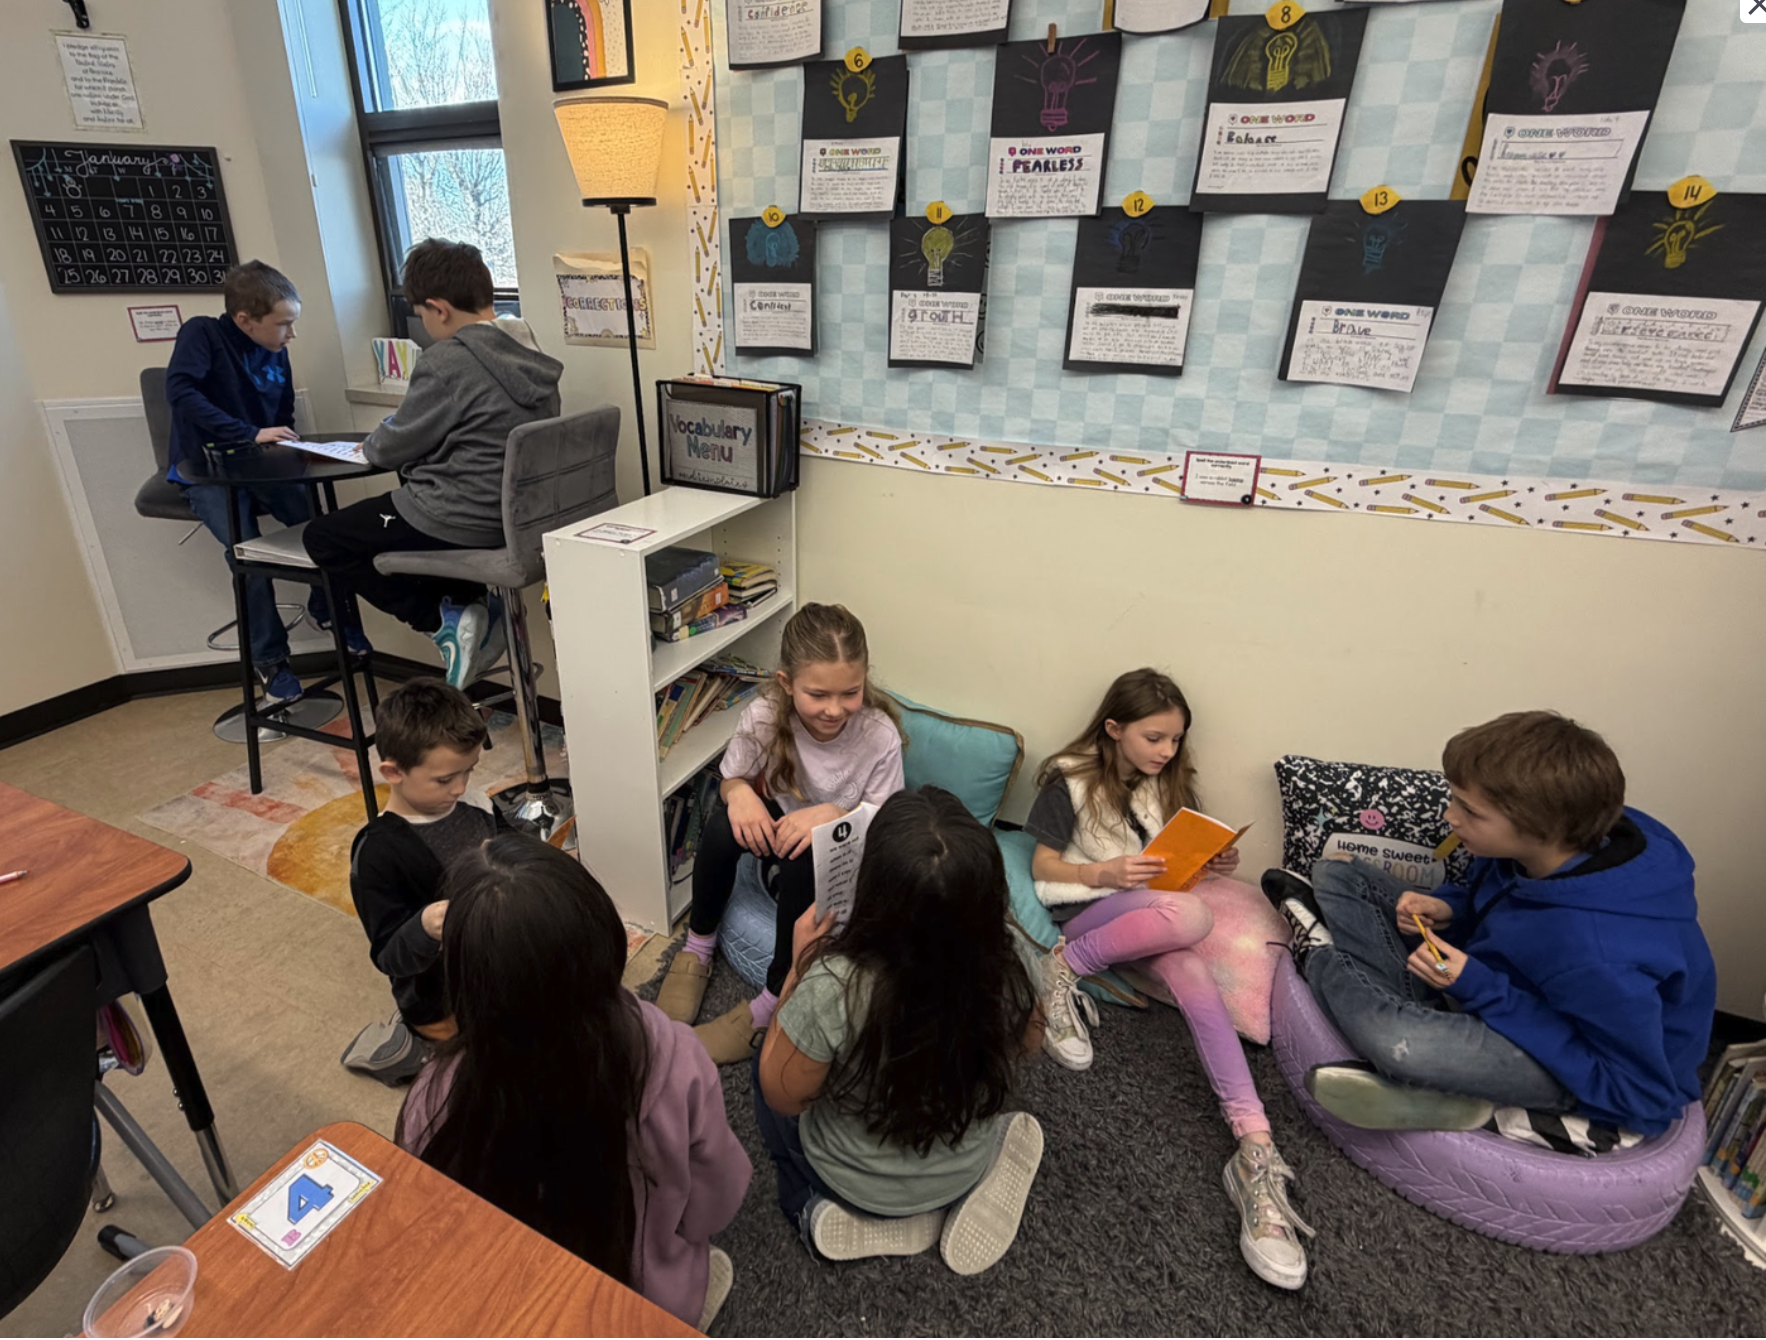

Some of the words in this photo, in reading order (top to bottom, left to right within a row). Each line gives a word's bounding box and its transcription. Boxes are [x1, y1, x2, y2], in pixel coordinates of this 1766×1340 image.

[1280, 6, 1291, 23] 8
[854, 53, 864, 68] 6
[1240, 115, 1270, 124] ONE
[1272, 114, 1315, 123] WORD
[1518, 128, 1554, 138] ONE
[1556, 127, 1612, 138] WORD
[829, 148, 850, 156] ONE
[852, 148, 881, 156] WORD
[1046, 146, 1082, 155] WORD
[64, 150, 160, 177] January
[1012, 158, 1084, 173] FEARLESS
[148, 186, 155, 197] 1
[172, 185, 182, 198] 2
[197, 186, 207, 199] 3
[1375, 191, 1388, 207] 13
[1684, 185, 1702, 201] 14
[1134, 198, 1144, 212] 12
[44, 204, 57, 217] 4
[70, 205, 83, 218] 5
[100, 206, 111, 218] 6
[123, 204, 135, 218] 7
[151, 204, 162, 219] 8
[176, 206, 188, 219] 9
[201, 208, 214, 221] 10
[768, 212, 780, 222] 10
[936, 206, 942, 219] 11
[50, 227, 64, 239] 11
[76, 227, 89, 241] 12
[102, 228, 116, 241] 13
[129, 227, 144, 240] 14
[154, 227, 169, 241] 15
[180, 227, 195, 241] 16
[204, 227, 217, 241] 17
[53, 247, 72, 263] 18
[82, 249, 96, 263] 19
[106, 248, 126, 262] 20
[133, 250, 148, 263] 21
[159, 250, 177, 264] 22
[182, 249, 201, 263] 23
[207, 250, 225, 263] 24
[57, 268, 80, 284] 25
[85, 269, 107, 284] 26
[111, 268, 129, 283] 27
[137, 268, 158, 285] 28
[162, 268, 180, 285] 29
[188, 269, 207, 284] 30
[1106, 293, 1132, 301] ONE
[1133, 294, 1170, 302] WORD
[1335, 308, 1365, 317] ONE
[1367, 309, 1410, 320] WORD
[1622, 306, 1658, 317] ONE
[1660, 308, 1718, 320] WORD
[1332, 319, 1372, 336] Brave
[669, 413, 752, 447] Vocabulary
[686, 435, 734, 464] Menu
[838, 824, 848, 838] 4
[287, 1173, 335, 1226] 4
